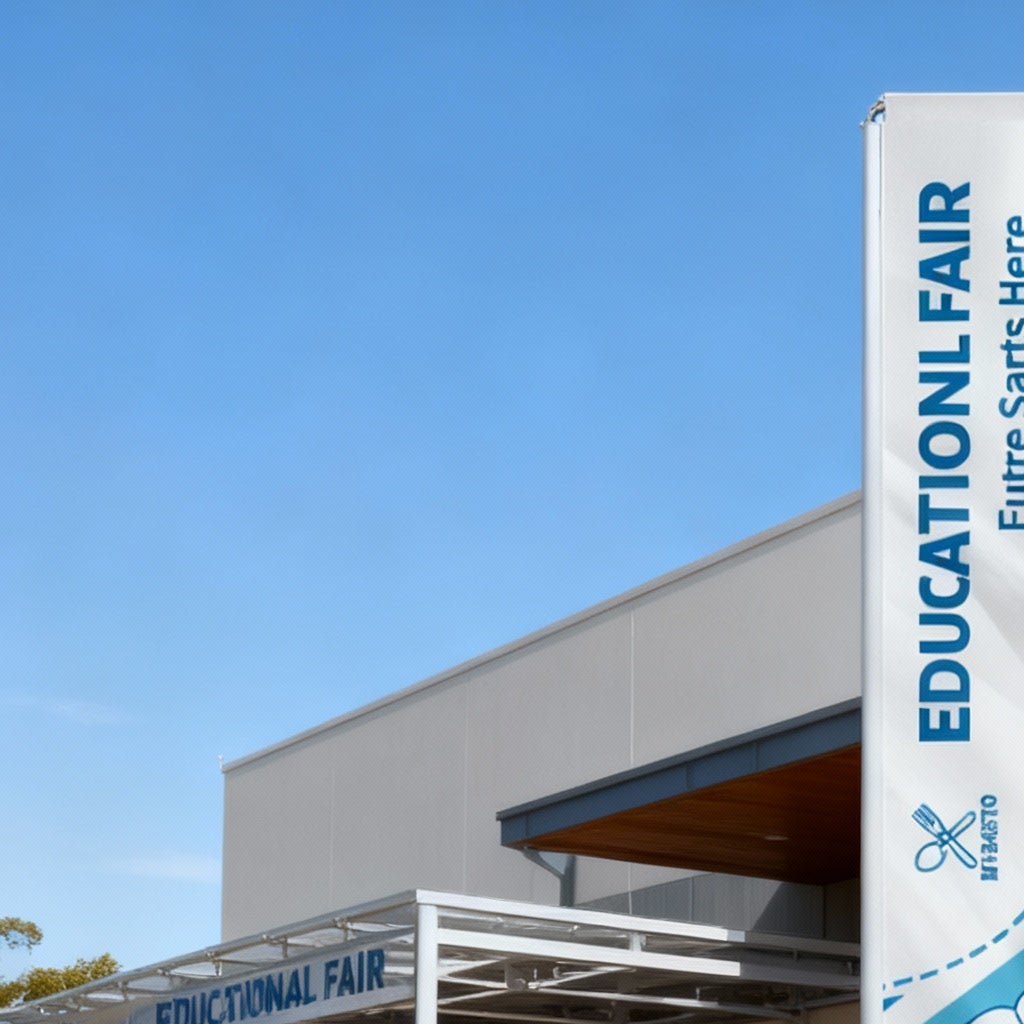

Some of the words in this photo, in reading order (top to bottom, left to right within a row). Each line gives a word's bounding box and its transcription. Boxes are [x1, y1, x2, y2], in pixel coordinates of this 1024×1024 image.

[918, 181, 971, 322] FAIR
[918, 334, 971, 742] EDUCATIONL
[323, 948, 385, 1001] FAIR
